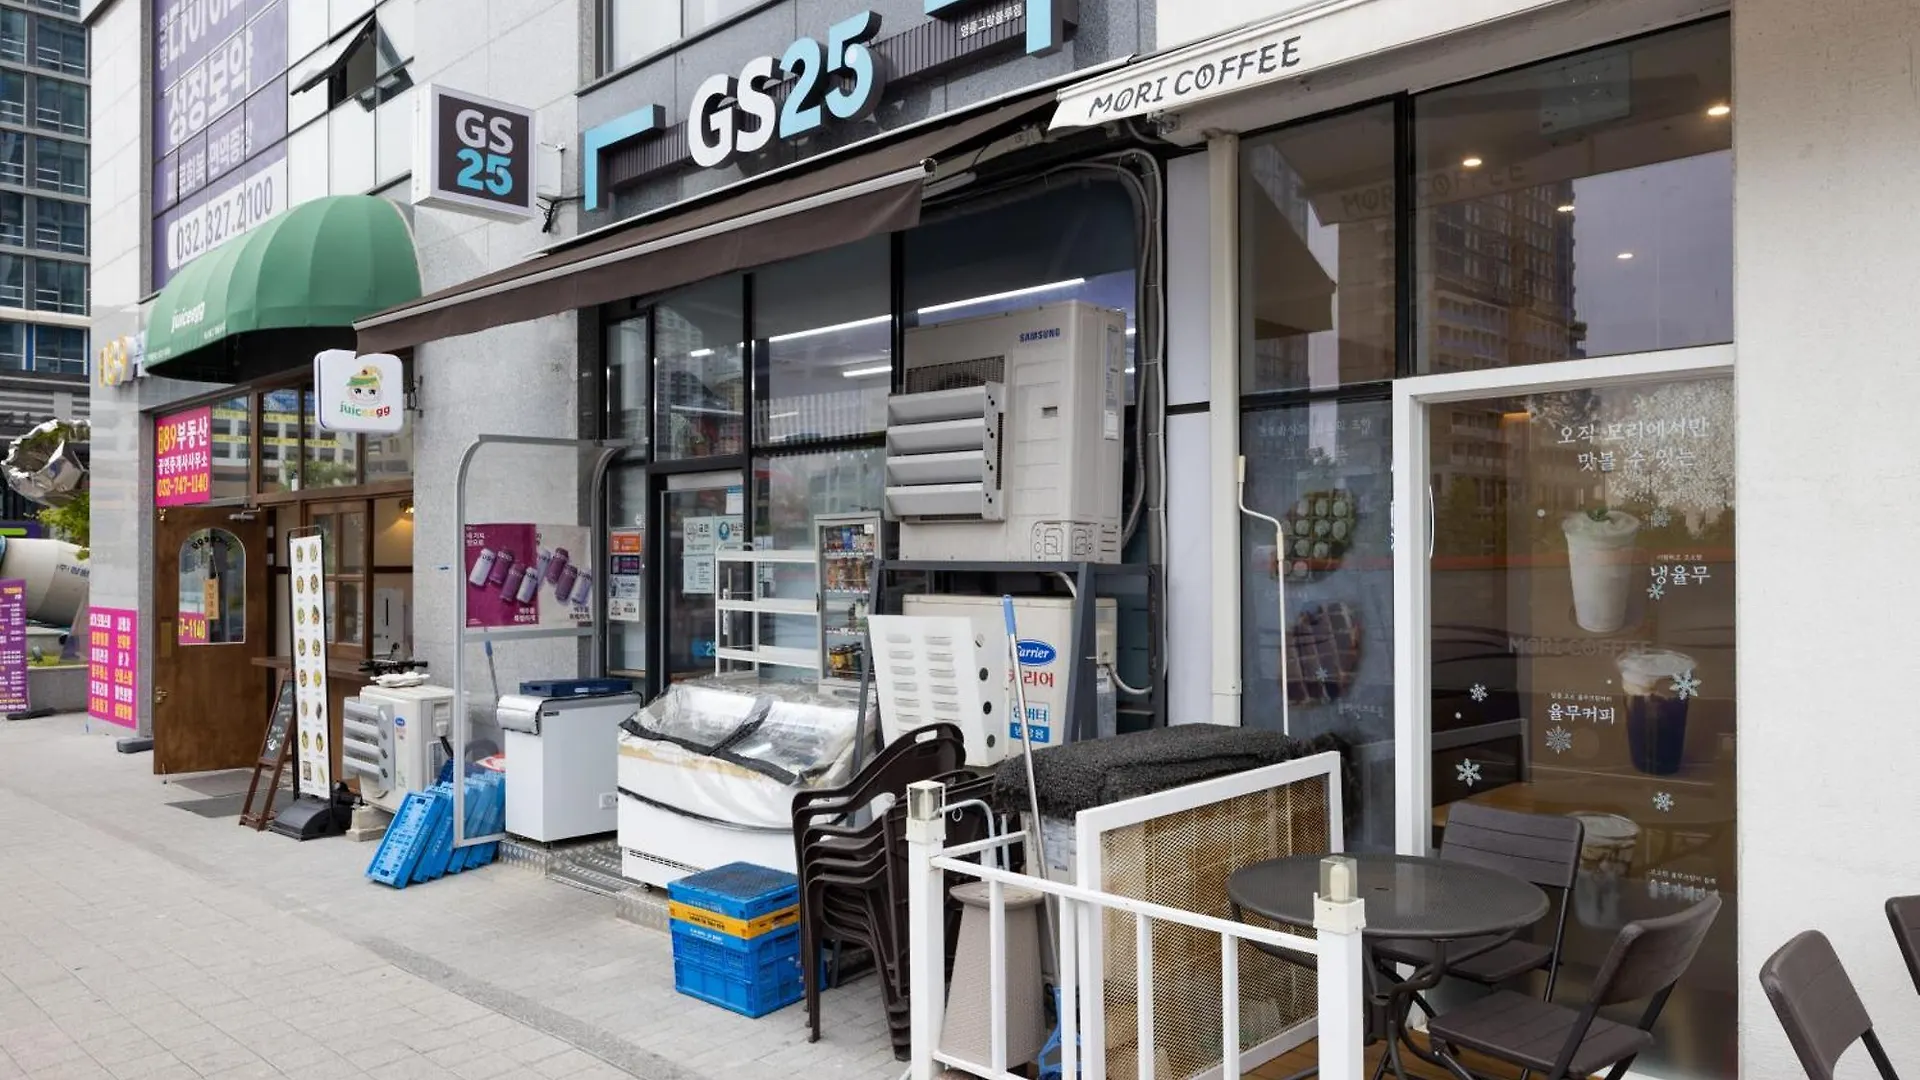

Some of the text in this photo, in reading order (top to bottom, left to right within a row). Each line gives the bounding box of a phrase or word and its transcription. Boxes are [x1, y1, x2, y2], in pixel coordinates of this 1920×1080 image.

[168, 28, 253, 144] 성장보약
[688, 10, 874, 168] GS25
[1088, 36, 1301, 118] MORI COFFEE
[456, 109, 514, 154] GS
[457, 148, 513, 195] 25
[177, 176, 273, 260] 032.327.2100
[1019, 328, 1060, 342] SAMSUNG
[1557, 415, 1710, 444] 오직 모리에서만
[1578, 448, 1697, 473] 맛볼 수 있는
[1650, 565, 1711, 586] 냉율무
[1548, 703, 1615, 725] 율무커피
